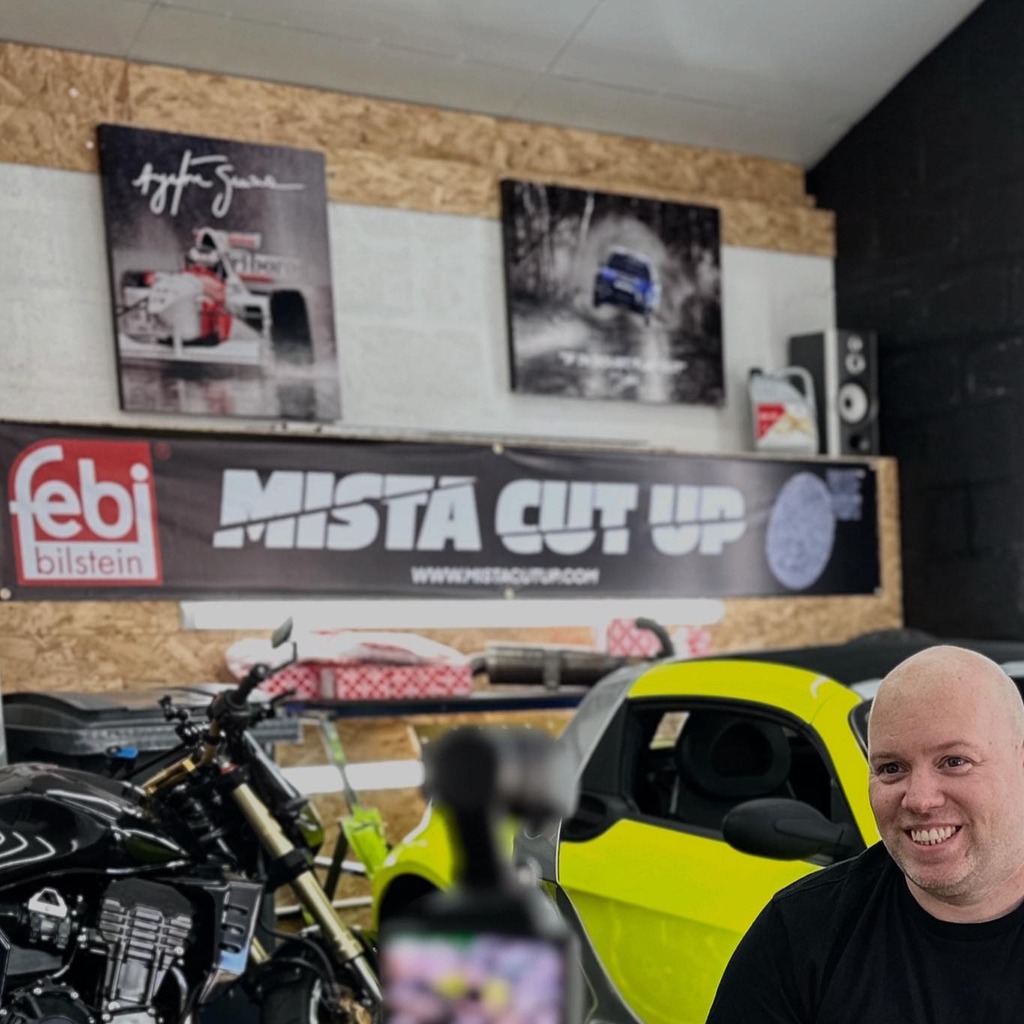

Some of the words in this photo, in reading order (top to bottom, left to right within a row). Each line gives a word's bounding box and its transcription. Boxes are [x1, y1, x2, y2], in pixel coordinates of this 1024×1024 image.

[9, 444, 150, 541] febi
[213, 469, 482, 551] MISTA
[496, 478, 638, 555] CUT
[649, 482, 747, 556] UP
[36, 546, 143, 575] bilstein
[411, 565, 600, 586] WWW.MISTACUTUP.COM
